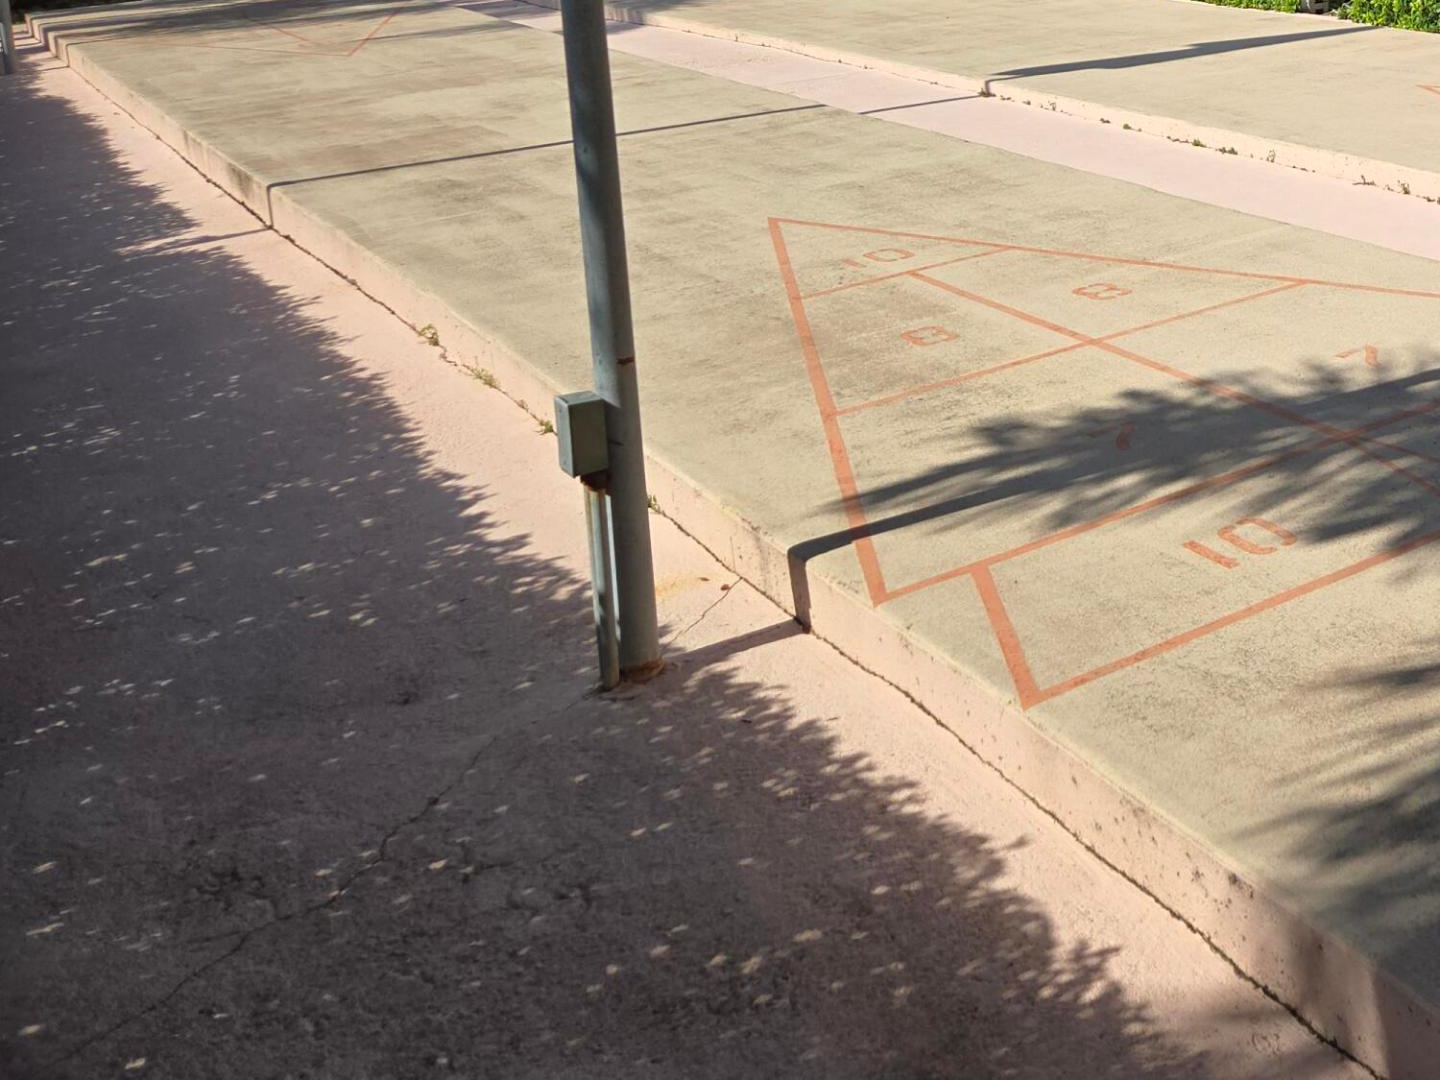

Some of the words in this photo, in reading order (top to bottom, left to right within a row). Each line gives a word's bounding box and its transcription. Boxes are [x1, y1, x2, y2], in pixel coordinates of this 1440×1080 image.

[842, 248, 916, 268] 10
[1071, 283, 1133, 300] 8
[1334, 344, 1380, 367] 7
[1183, 518, 1297, 569] 10
